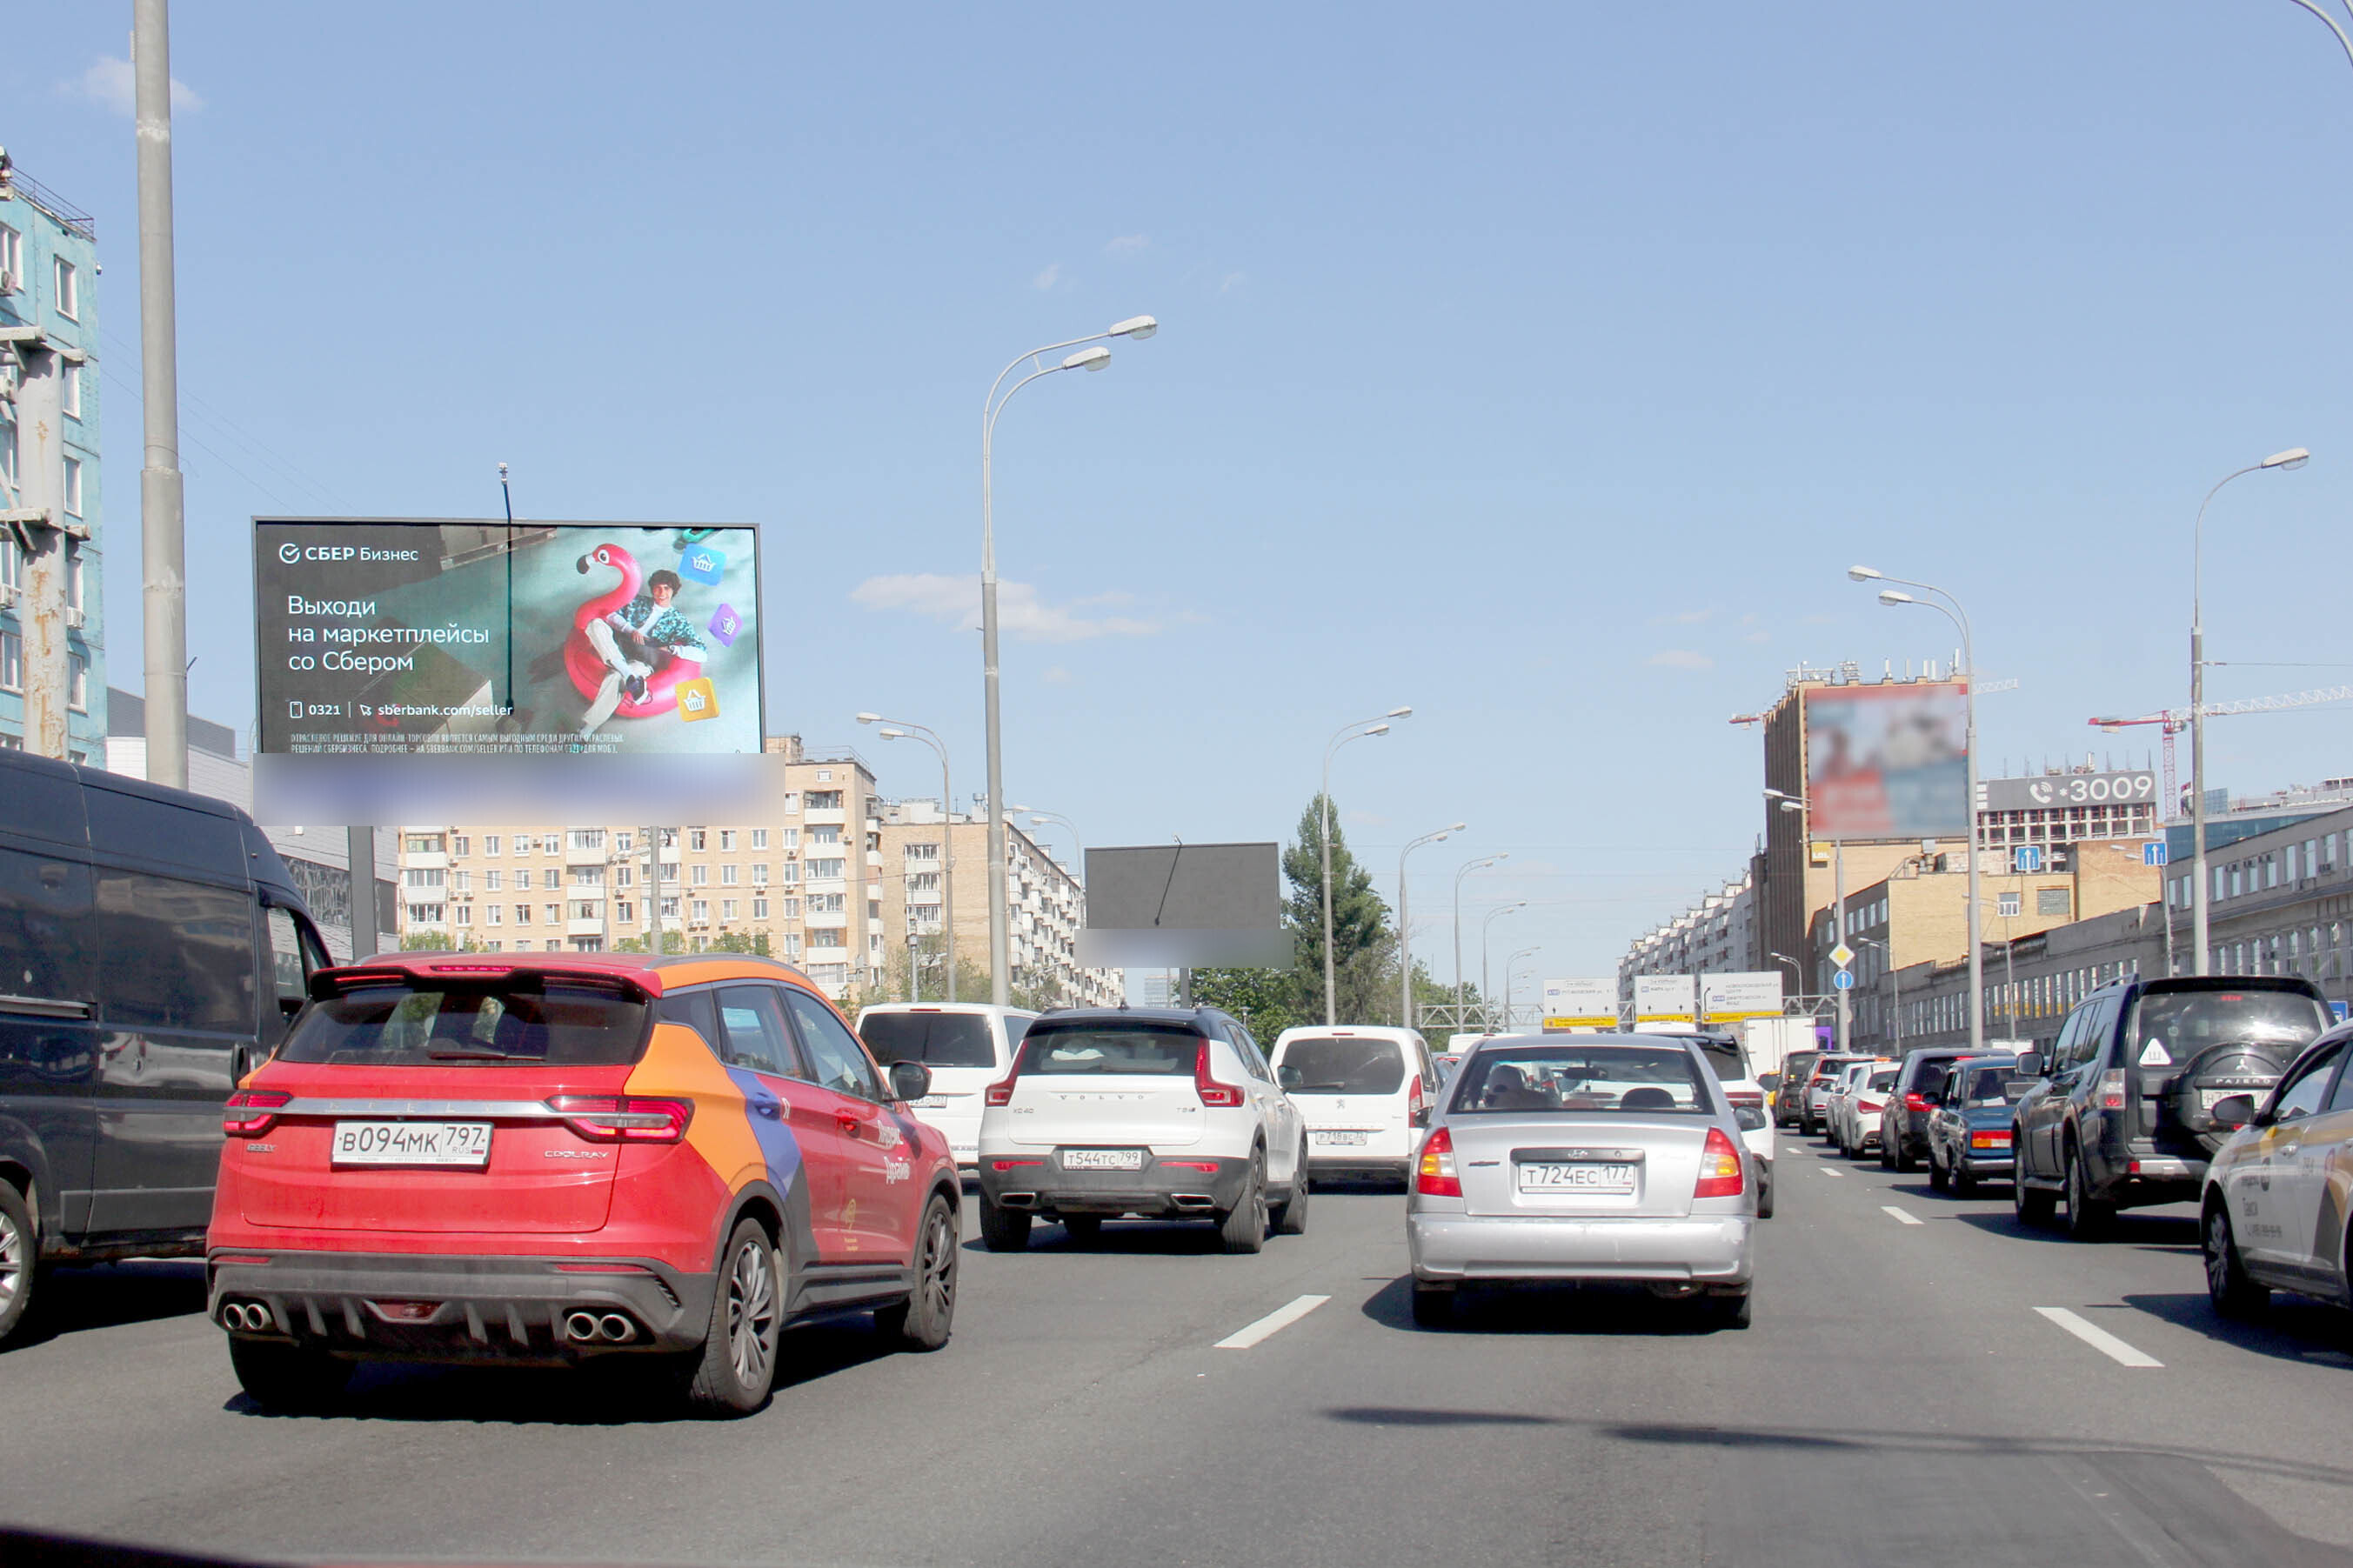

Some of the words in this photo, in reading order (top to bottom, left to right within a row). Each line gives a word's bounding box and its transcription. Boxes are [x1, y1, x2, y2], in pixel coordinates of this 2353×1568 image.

[305, 546, 355, 561] СБЕР
[360, 547, 419, 561] Бизнес
[288, 595, 376, 618] Выходи
[288, 628, 315, 643] на
[323, 623, 490, 646] маркетплейсы
[289, 656, 315, 671] со
[323, 651, 414, 675] Сбером
[308, 704, 341, 716] 0321
[378, 704, 513, 717] sberbank.com/seller
[343, 1127, 439, 1152] В094МК
[445, 1126, 484, 1146] 797
[544, 1151, 609, 1159] COOLRAY
[1527, 1165, 1598, 1184] Т724ЕС
[1602, 1165, 1629, 1180] 177
